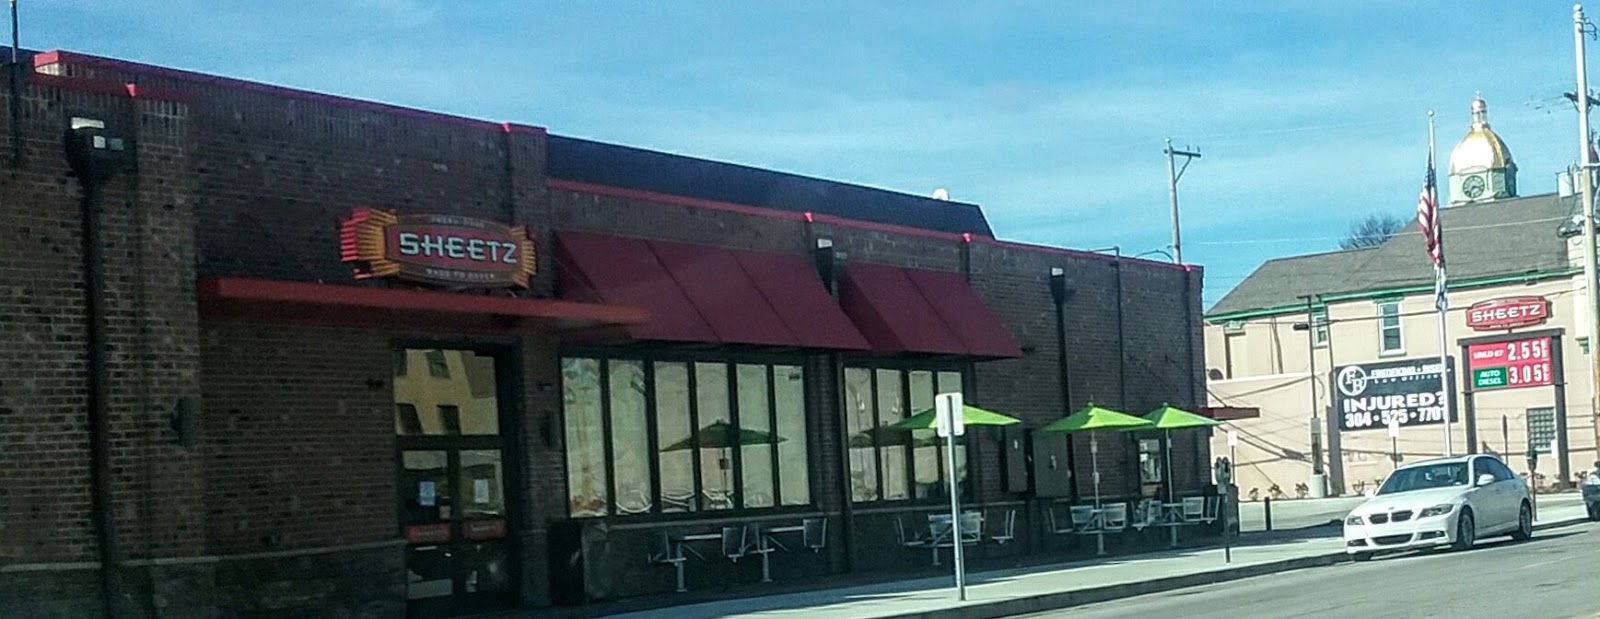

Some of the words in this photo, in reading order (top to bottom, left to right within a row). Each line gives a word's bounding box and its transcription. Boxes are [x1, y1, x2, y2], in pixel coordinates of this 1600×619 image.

[400, 232, 517, 264] SHEETZ
[1472, 304, 1541, 322] SHEETZ
[1478, 377, 1503, 386] DIESEL
[1479, 369, 1501, 378] AUTO
[1343, 391, 1445, 413] INJURED?
